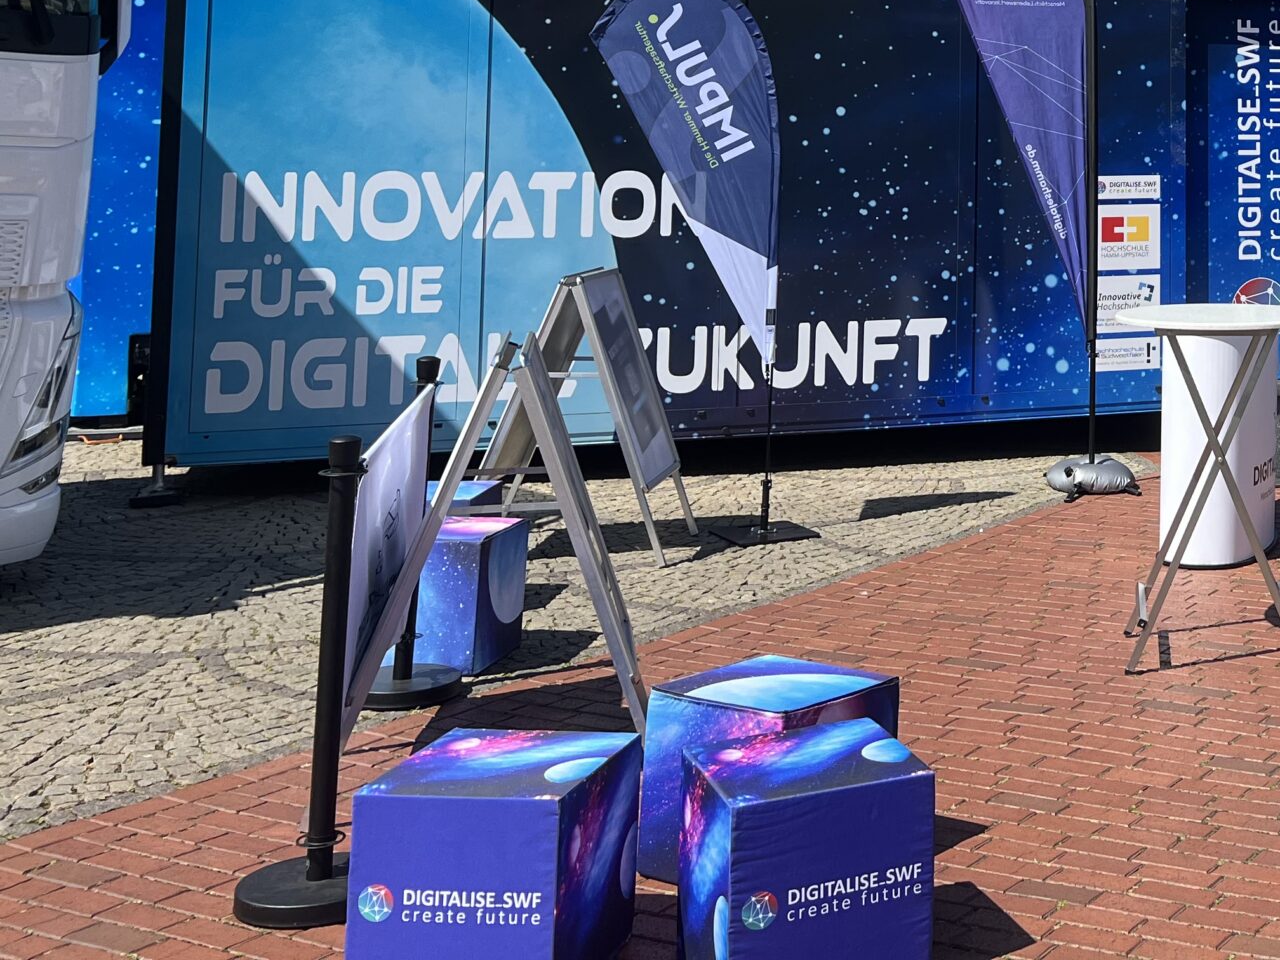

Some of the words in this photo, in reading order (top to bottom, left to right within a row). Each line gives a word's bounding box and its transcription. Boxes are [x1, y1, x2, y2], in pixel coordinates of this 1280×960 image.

[1101, 244, 1149, 253] HOCHSCHULE
[213, 254, 335, 319] FÜR
[355, 265, 444, 315] DIE
[1098, 292, 1141, 302] Innovative
[637, 318, 948, 394] UKUNFT
[786, 896, 852, 923] create
[860, 880, 923, 907] future
[401, 908, 466, 924] create
[476, 908, 541, 926] future
